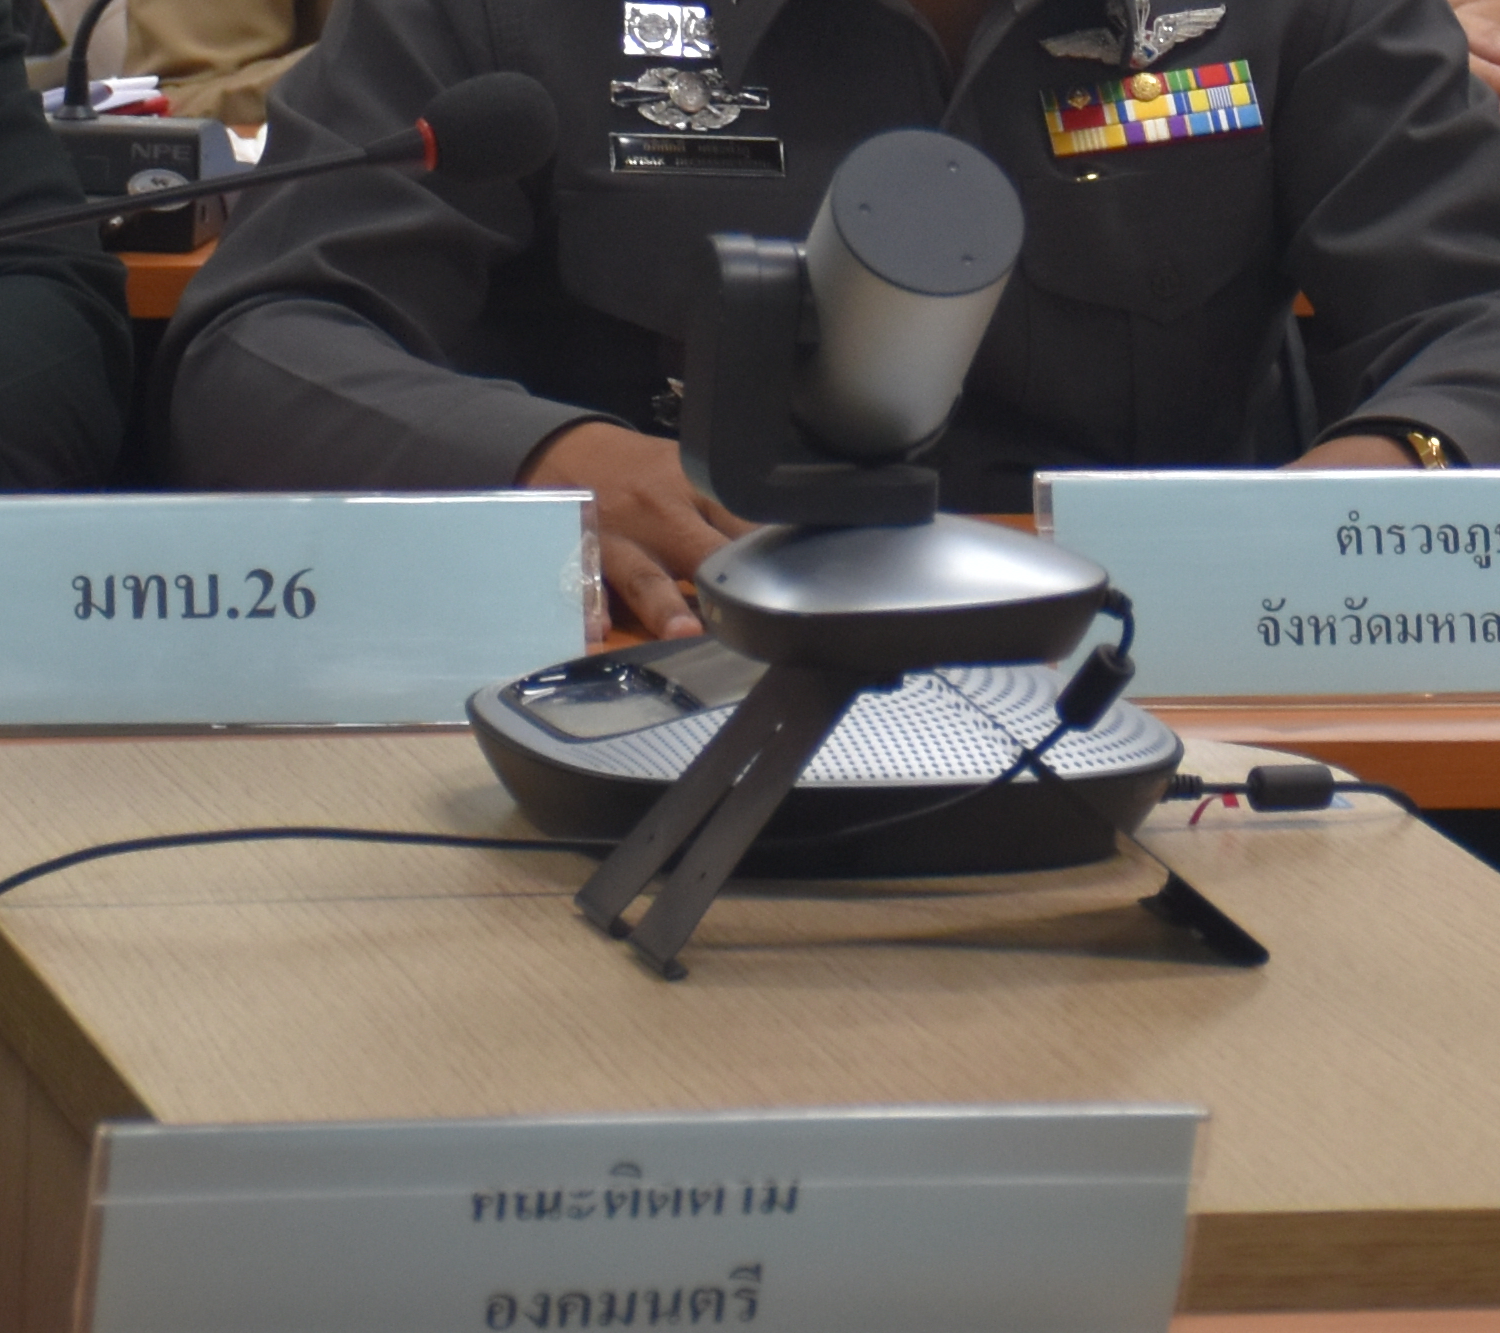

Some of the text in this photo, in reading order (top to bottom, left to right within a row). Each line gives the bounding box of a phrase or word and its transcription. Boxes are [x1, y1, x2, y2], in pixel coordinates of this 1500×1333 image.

[131, 142, 192, 161] NPE
[71, 567, 318, 621] มทบ.26
[484, 1263, 763, 1331] องคมนตรี
